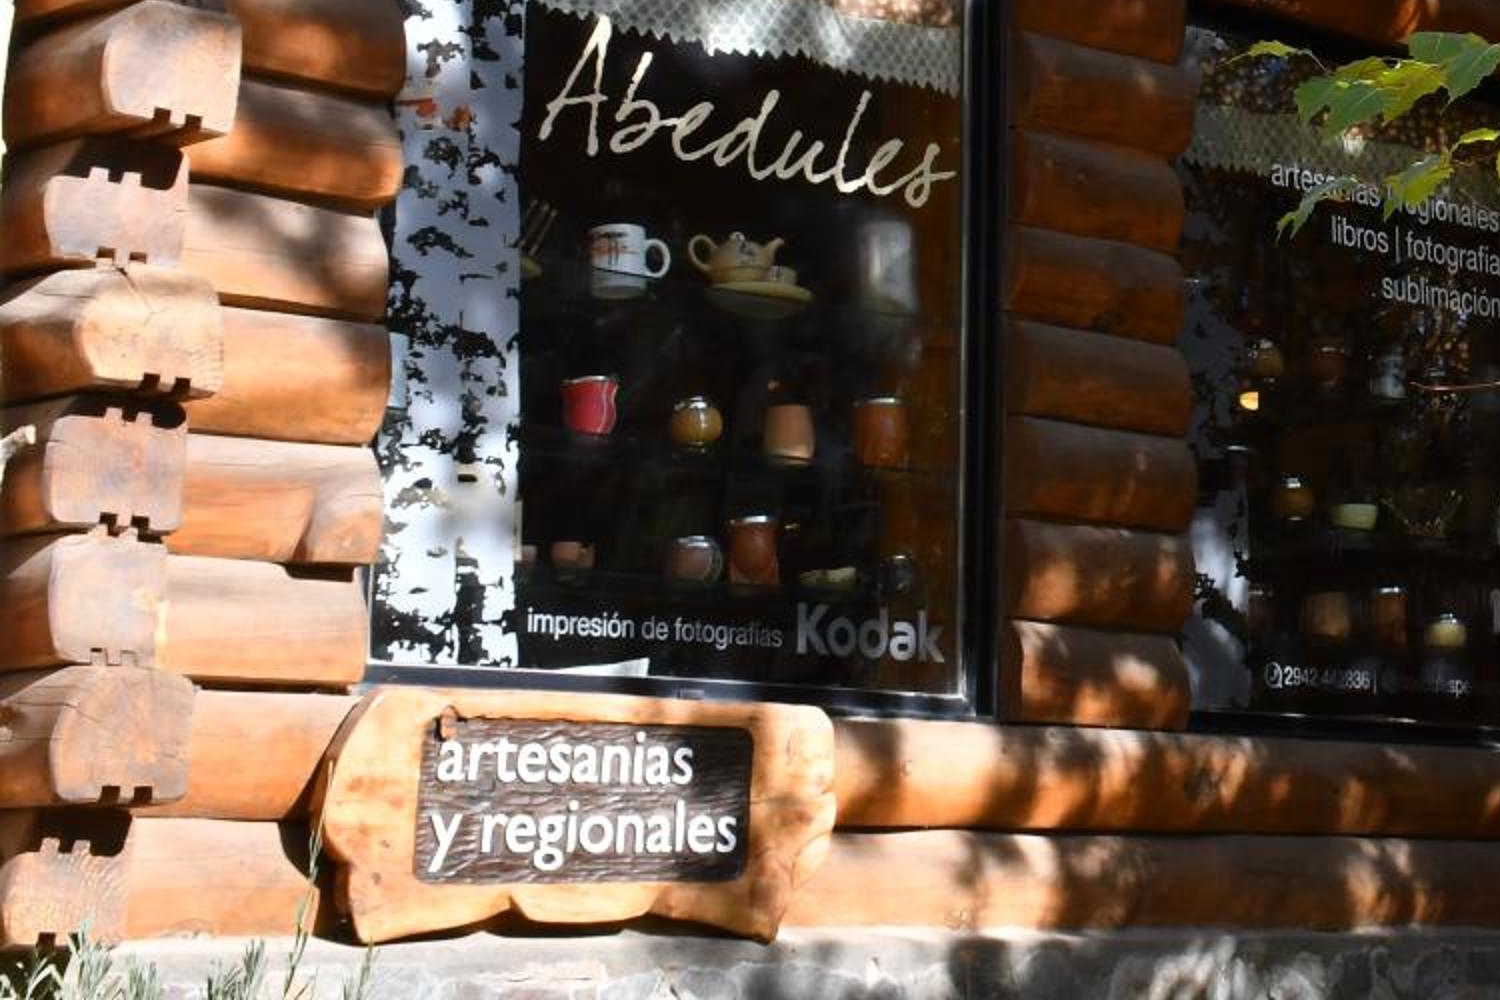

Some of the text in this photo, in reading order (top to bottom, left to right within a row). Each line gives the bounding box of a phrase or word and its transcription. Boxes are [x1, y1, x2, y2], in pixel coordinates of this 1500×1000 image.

[538, 14, 957, 208] Abedules
[1330, 215, 1389, 253] libros
[526, 607, 634, 640] impresión
[641, 614, 668, 641] de
[797, 602, 945, 664] Kodak
[427, 799, 737, 873] y regionales
